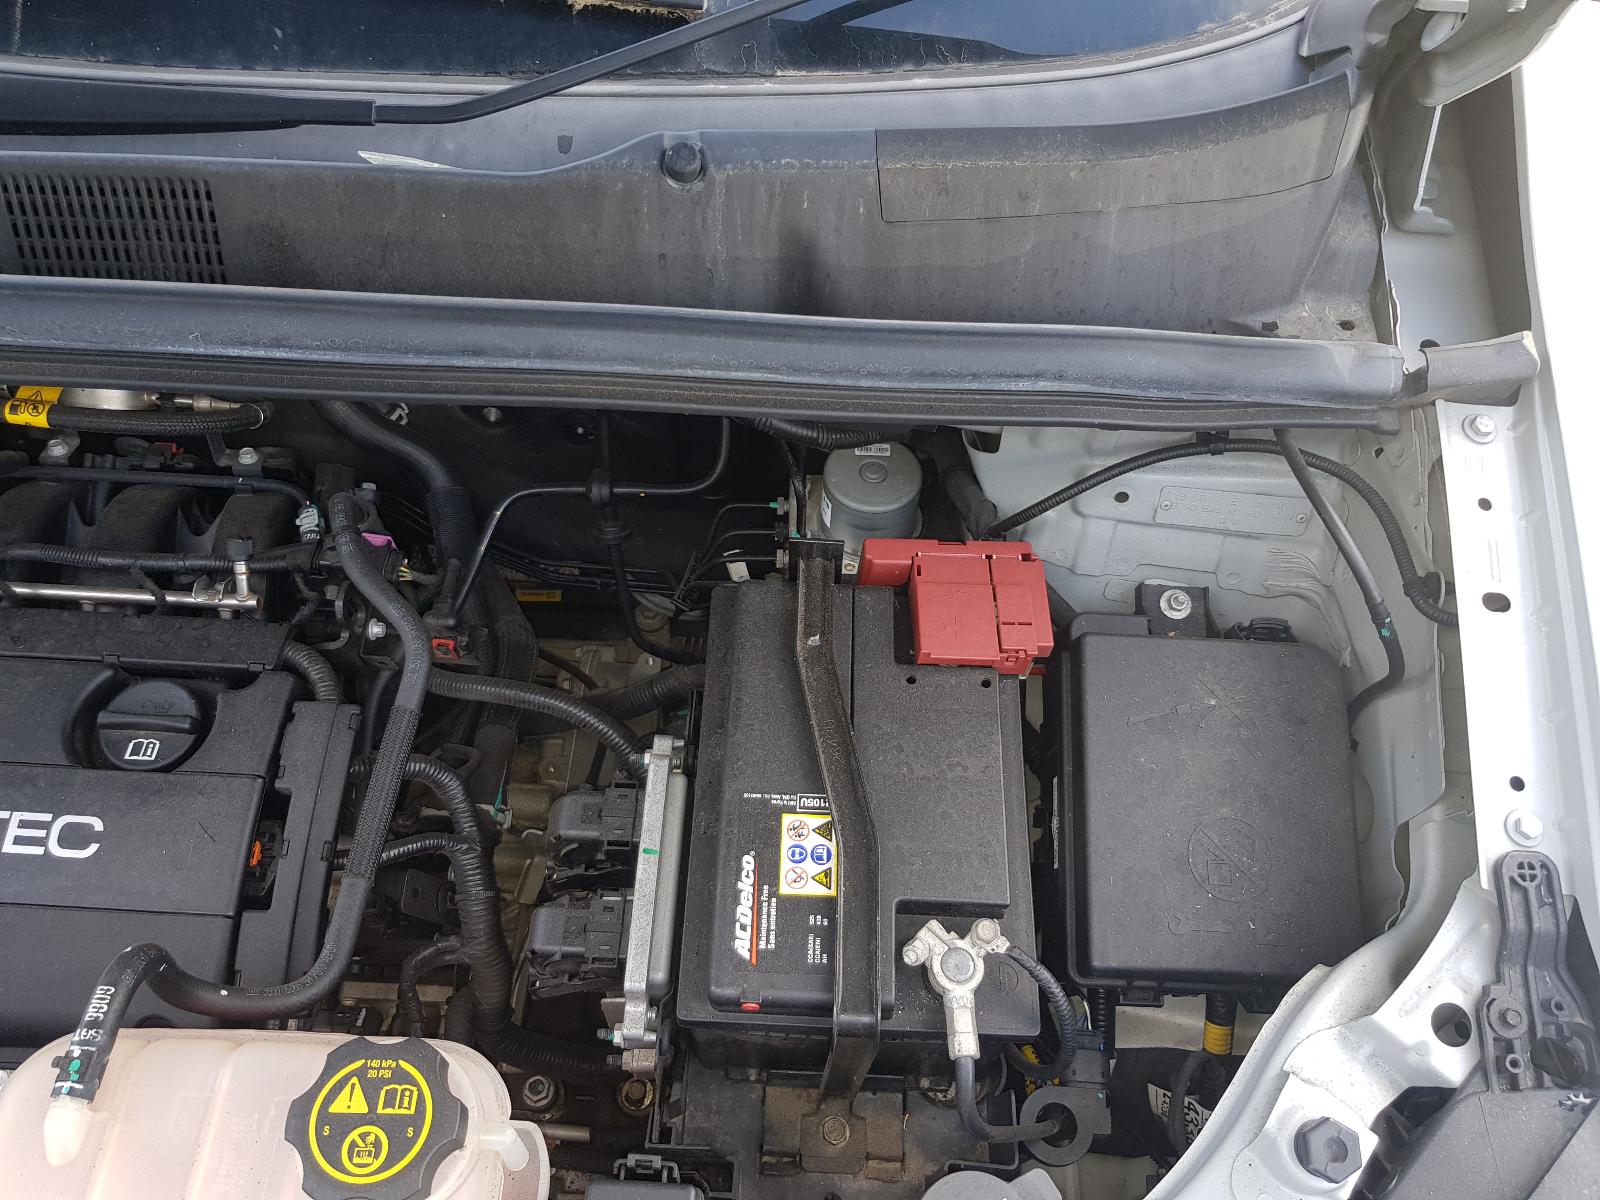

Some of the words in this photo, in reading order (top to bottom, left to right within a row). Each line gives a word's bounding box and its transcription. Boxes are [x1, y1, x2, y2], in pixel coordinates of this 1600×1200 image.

[0, 811, 104, 859] EC
[761, 885, 769, 900] Free
[759, 901, 768, 949] Maintenance
[768, 930, 776, 949] Sans
[822, 953, 828, 963] AH
[366, 1059, 381, 1068] 140
[381, 1059, 397, 1068] kPa
[367, 1070, 378, 1078] 20
[378, 1070, 392, 1078] PSI
[323, 1125, 330, 1136] S
[406, 1127, 414, 1138] S
